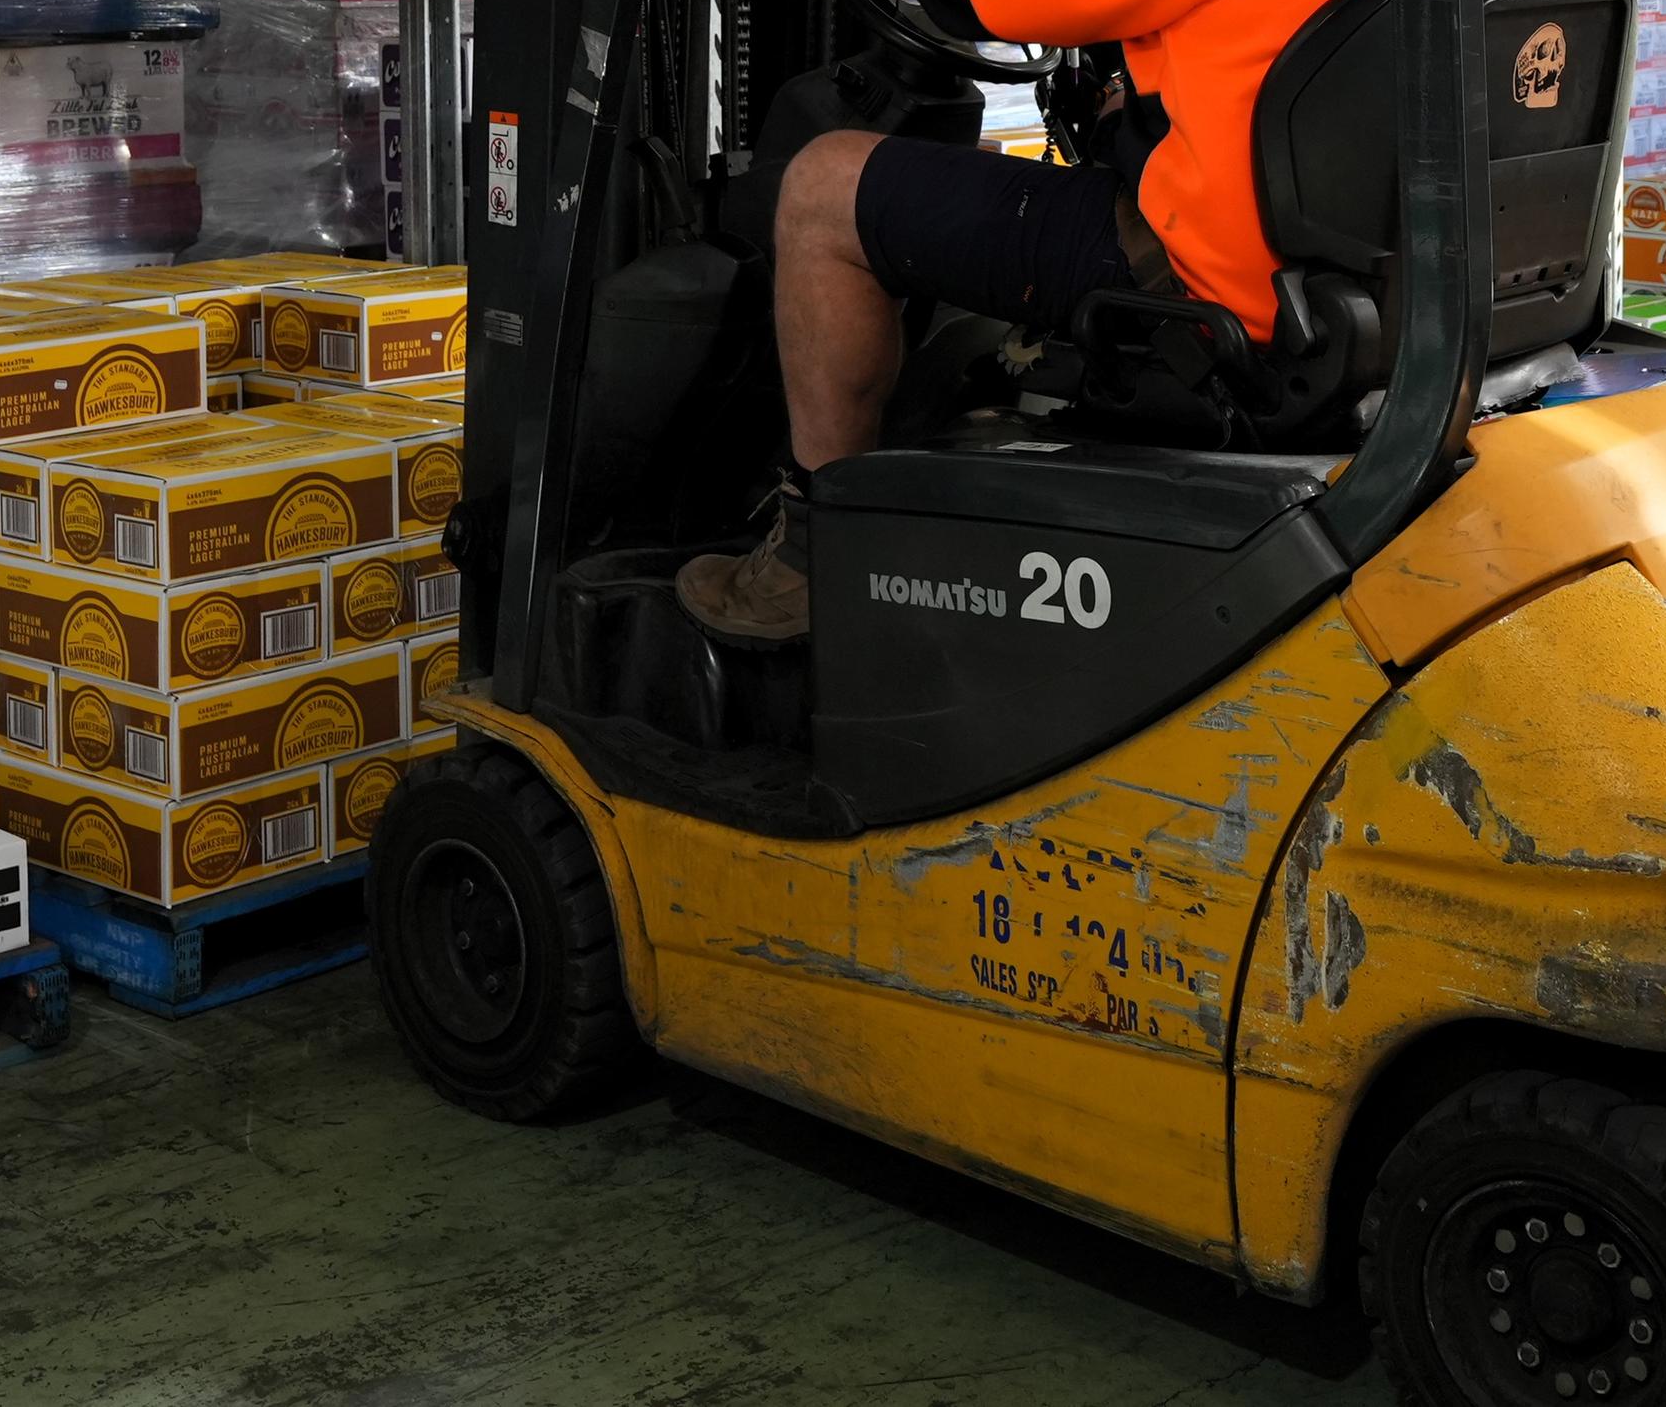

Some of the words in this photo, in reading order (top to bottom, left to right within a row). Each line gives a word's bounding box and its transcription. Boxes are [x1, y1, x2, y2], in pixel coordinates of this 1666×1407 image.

[144, 49, 161, 67] 12
[92, 373, 106, 390] THE
[109, 365, 148, 385] STANDARD
[0, 391, 48, 407] PREMIUM
[0, 399, 61, 418] AUSTRALIAN
[86, 395, 157, 420] HAWKESBURY
[0, 415, 32, 429] LAGER
[189, 524, 238, 541] PREMIUM
[276, 524, 347, 554] HAWKESBURY
[189, 533, 251, 554] AUSTRALIAN
[189, 548, 222, 564] LAGER
[869, 572, 1007, 618] KOMATSU
[1019, 551, 1111, 630] 20
[68, 645, 122, 676] HAWKESBURY
[971, 953, 1017, 994] SALES
